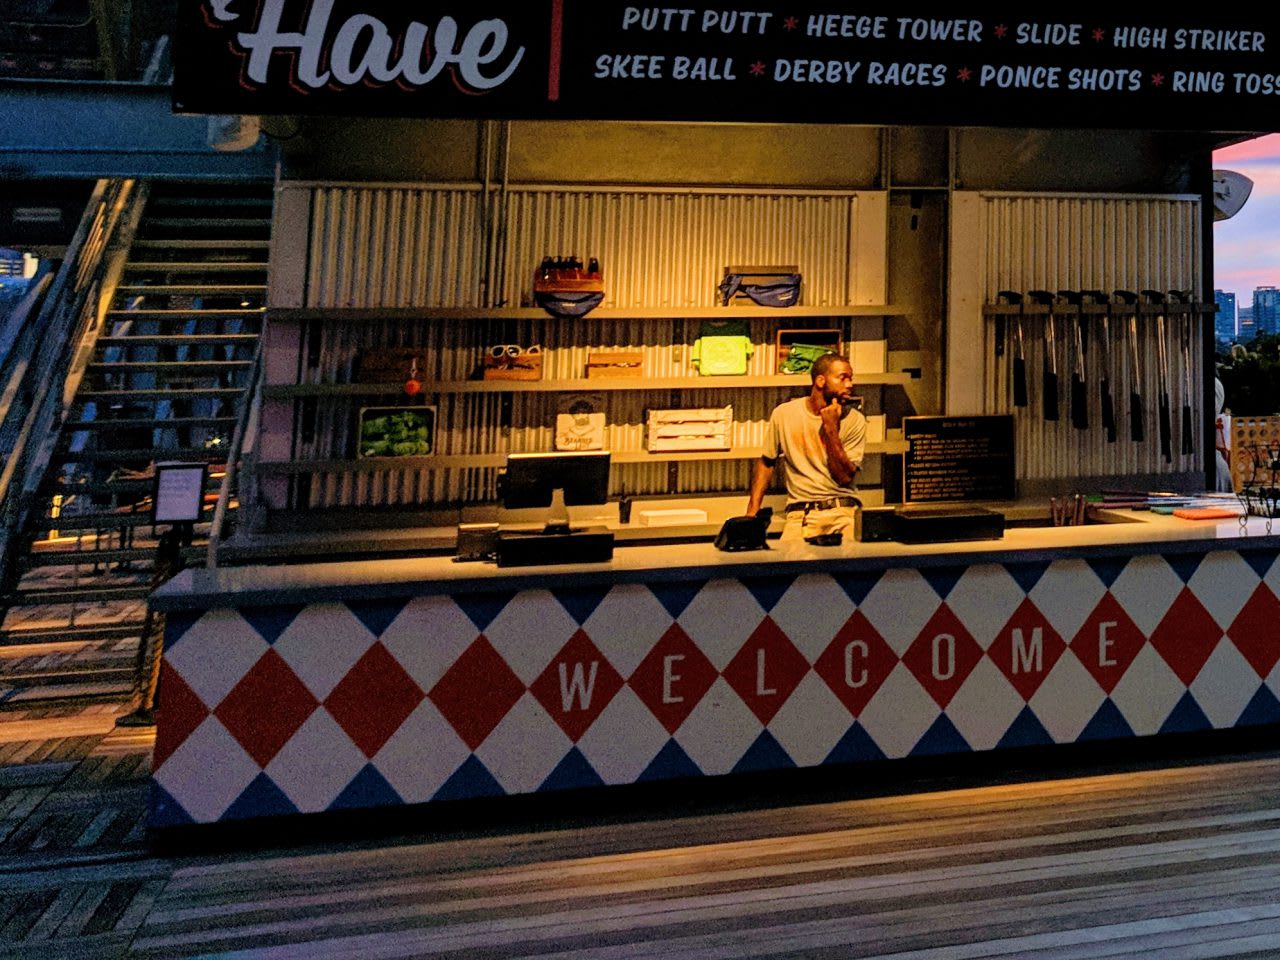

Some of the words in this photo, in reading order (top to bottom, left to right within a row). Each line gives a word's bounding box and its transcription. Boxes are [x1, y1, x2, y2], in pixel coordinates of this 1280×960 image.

[622, 6, 696, 32] PUTT
[701, 8, 773, 36] PUTT
[806, 14, 889, 39] HEEGE
[896, 17, 983, 43] TOWER
[1015, 22, 1083, 46] SLIDE
[1113, 26, 1168, 50] HIGH
[1173, 28, 1266, 53] STRIKER
[594, 54, 666, 79] SKEE
[672, 55, 737, 81] BALL
[773, 58, 861, 84] DERBY
[866, 61, 948, 87] RACES
[979, 64, 1062, 89] PONCE
[1067, 67, 1143, 92] SHOTS
[1172, 70, 1225, 94] RING
[557, 621, 1118, 712] WELCOME
